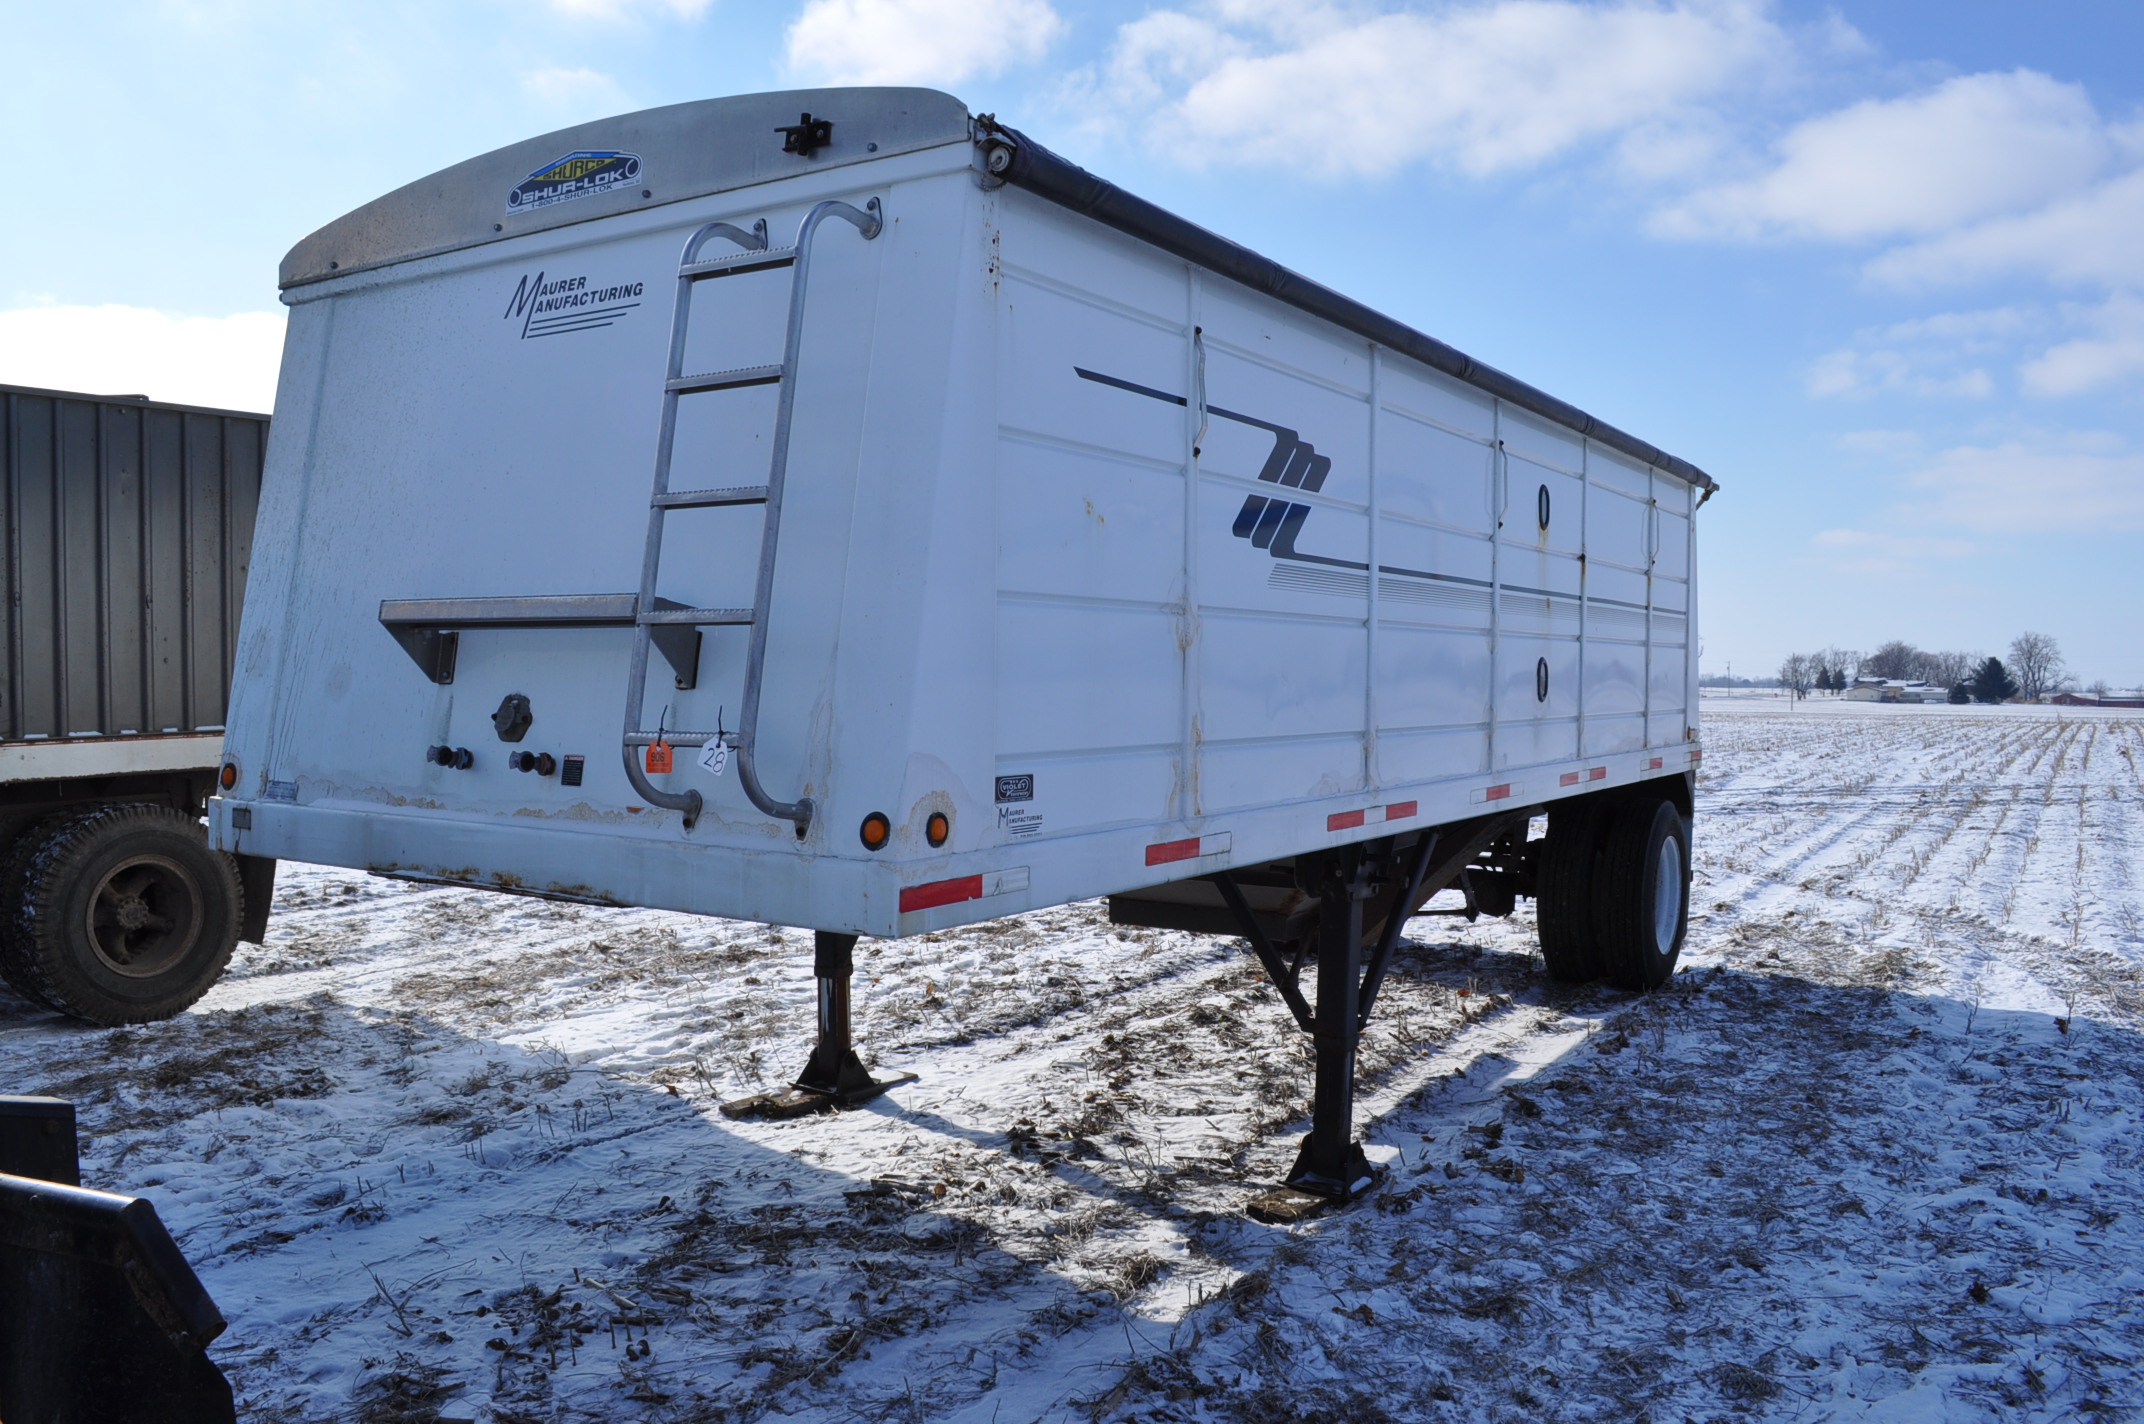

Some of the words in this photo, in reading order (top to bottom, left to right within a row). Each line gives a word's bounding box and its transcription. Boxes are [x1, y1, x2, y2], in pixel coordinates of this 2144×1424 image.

[522, 169, 624, 203] SHUR-LOK
[531, 184, 613, 208] 1-800-4-SHUR-LOK
[704, 748, 725, 772] 28
